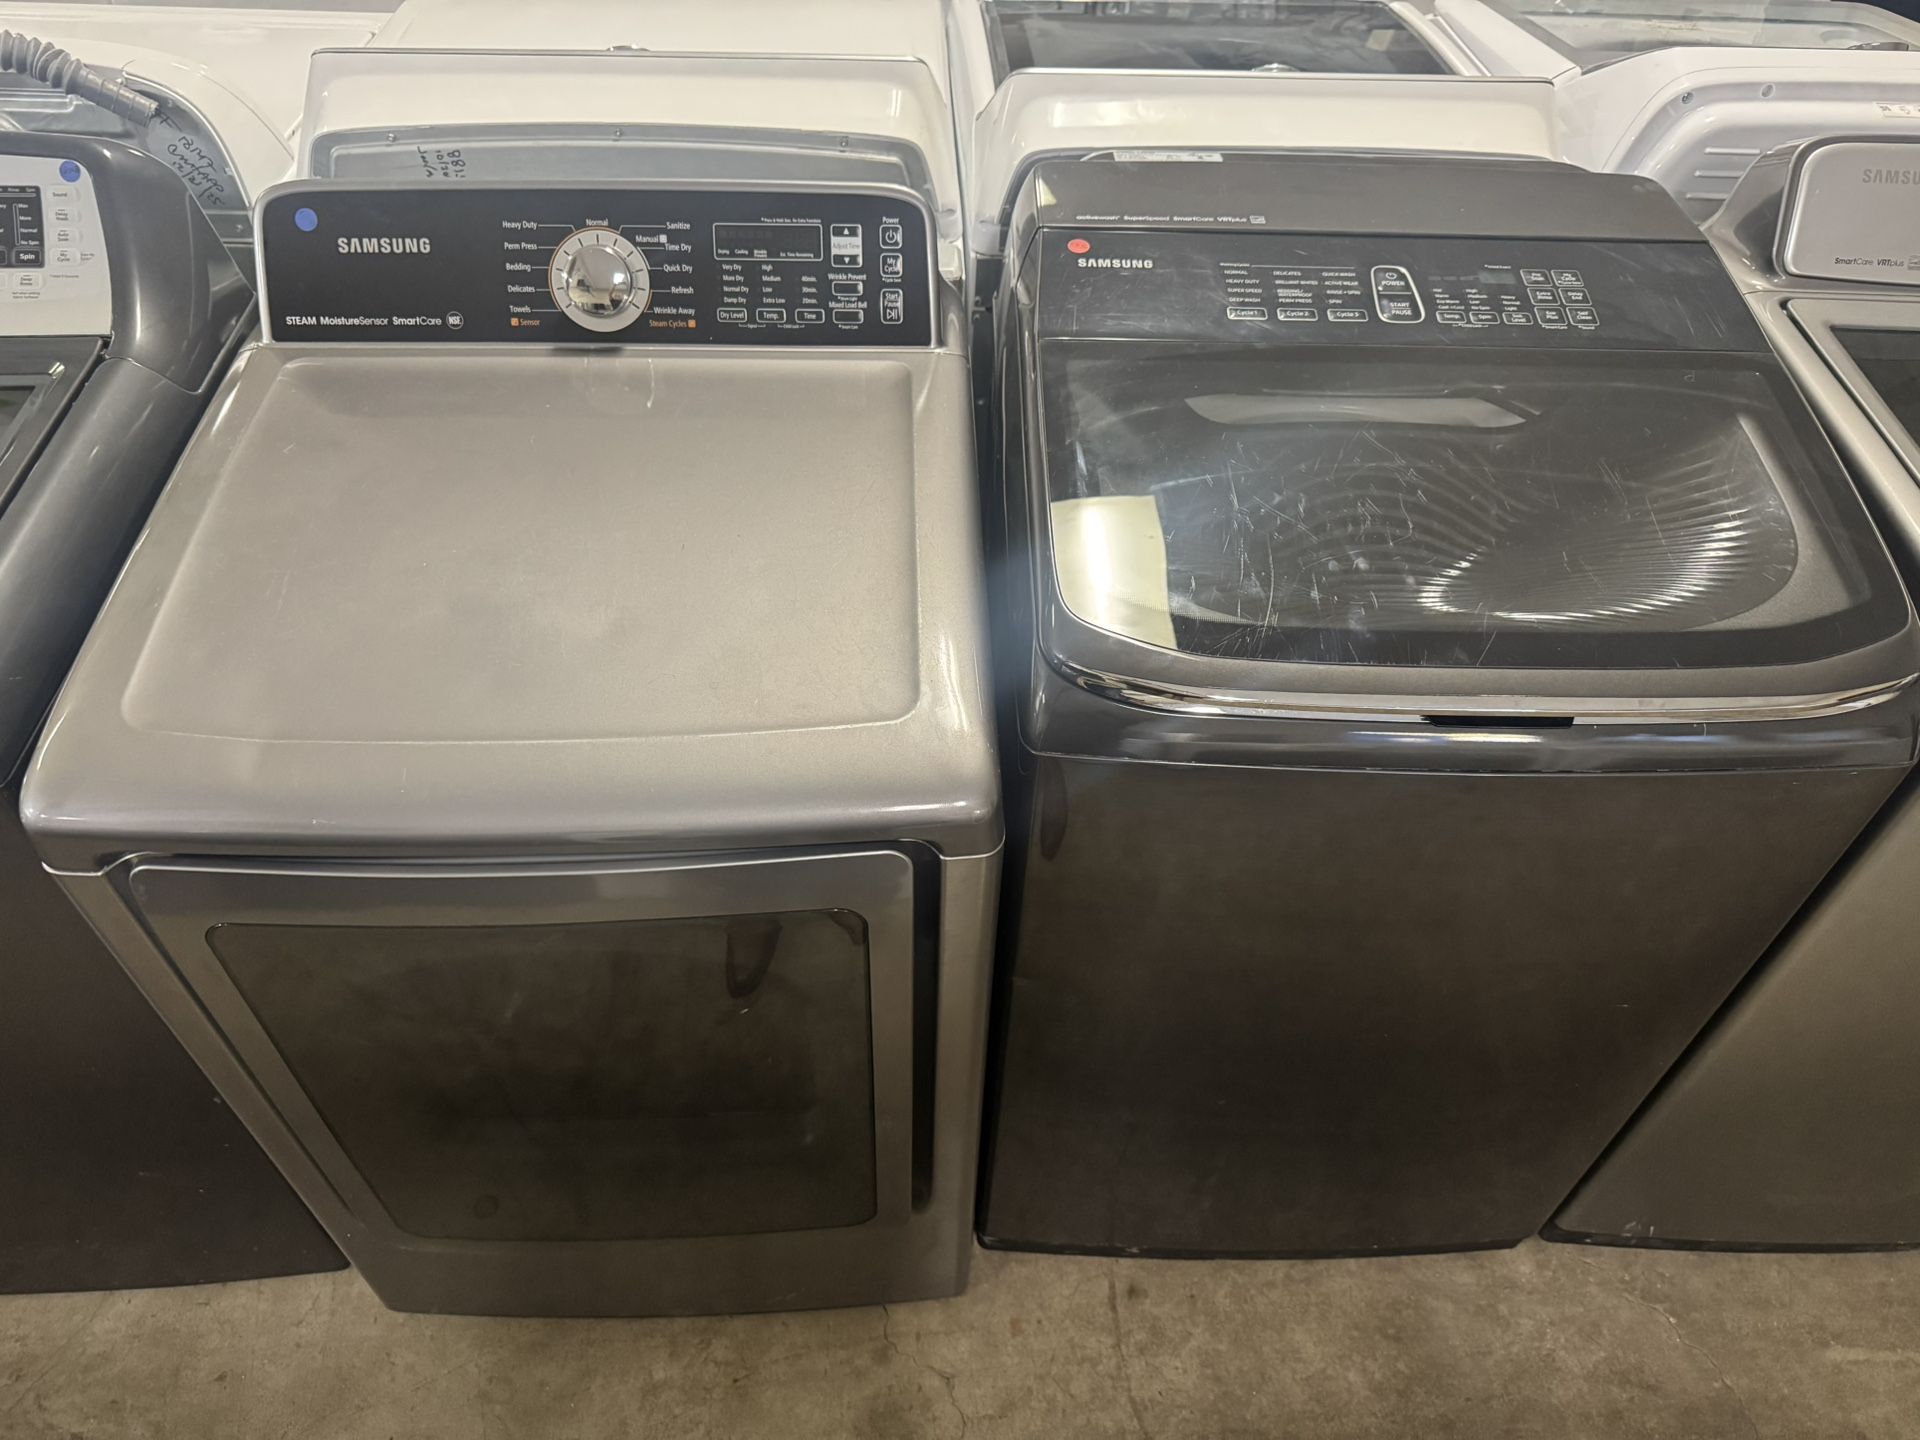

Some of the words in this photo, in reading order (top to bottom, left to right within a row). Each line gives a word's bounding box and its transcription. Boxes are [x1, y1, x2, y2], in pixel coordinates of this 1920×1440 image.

[586, 218, 609, 227] Normal
[882, 216, 900, 224] Power
[502, 220, 521, 230] Heavy
[522, 220, 537, 230] Duty
[666, 221, 691, 230] Sanitize
[636, 235, 659, 243] Manual
[337, 237, 431, 254] SAMSUNG
[504, 242, 519, 250] Perm
[521, 242, 537, 250] Press
[665, 243, 679, 252] Time
[680, 243, 692, 253] Dry
[19, 253, 35, 261] Spin
[887, 257, 896, 265] My
[1077, 258, 1154, 269] SAMSUNG
[1834, 257, 1874, 266] SmartCare
[1877, 258, 1905, 267] VRTplus
[505, 263, 531, 272] Bedding
[663, 264, 680, 273] Quick
[681, 264, 693, 273] Dry
[733, 264, 742, 272] Dry
[761, 264, 773, 272] High
[507, 285, 535, 293] Delicates
[671, 286, 694, 295] Refresh
[885, 292, 899, 300] Start
[510, 305, 531, 313] Towels
[654, 307, 677, 315] Wrinkle
[678, 307, 696, 316] Away
[286, 316, 317, 326] STEAM
[320, 316, 389, 326] MoistureSensor
[392, 316, 442, 326] SmartCare
[520, 318, 541, 327] Sensor
[649, 320, 668, 328] Steam
[669, 320, 688, 329] Cycles
